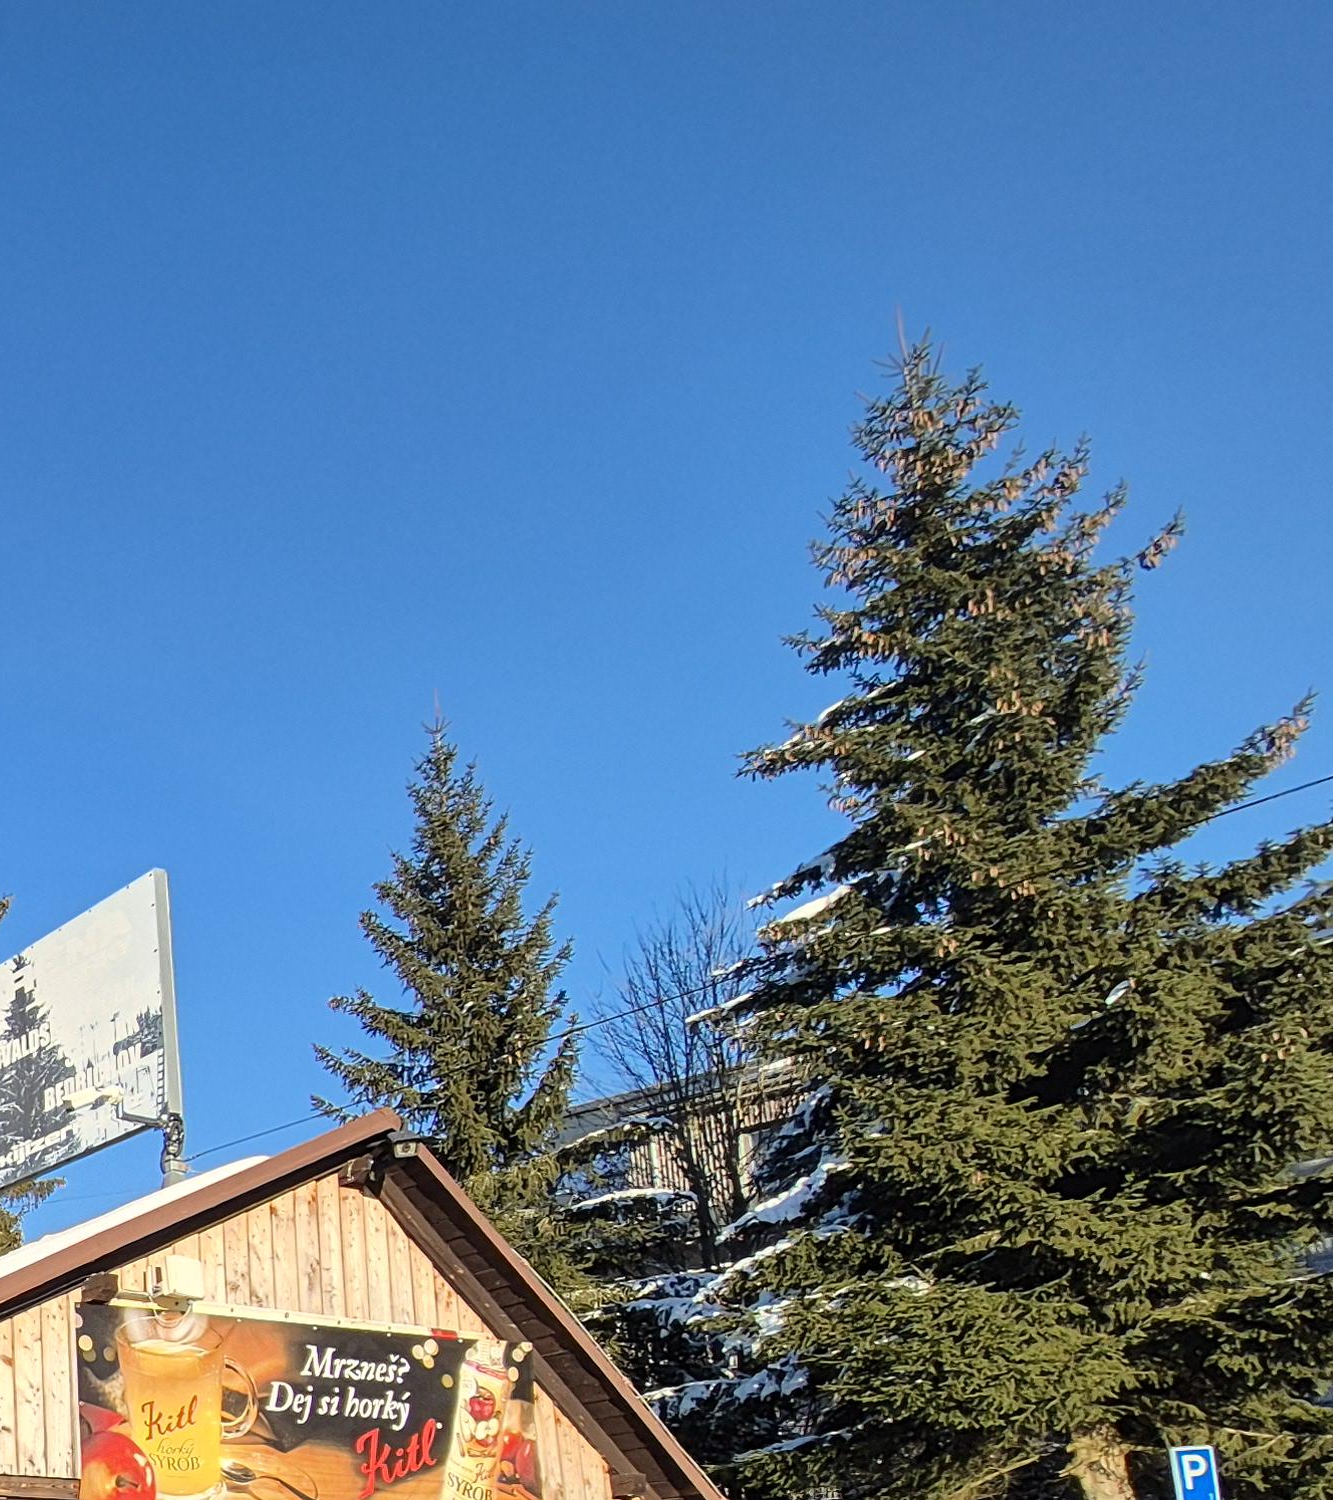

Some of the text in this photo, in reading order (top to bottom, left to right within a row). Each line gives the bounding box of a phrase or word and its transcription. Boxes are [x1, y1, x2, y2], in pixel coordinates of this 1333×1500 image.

[300, 1344, 411, 1385] Mrzneš?
[141, 1394, 198, 1440] Kitl
[265, 1381, 411, 1431] Dej si horký
[148, 1452, 201, 1472] SYROB
[156, 1437, 195, 1458] horký
[355, 1418, 437, 1500] Kitl
[1181, 1454, 1208, 1490] P
